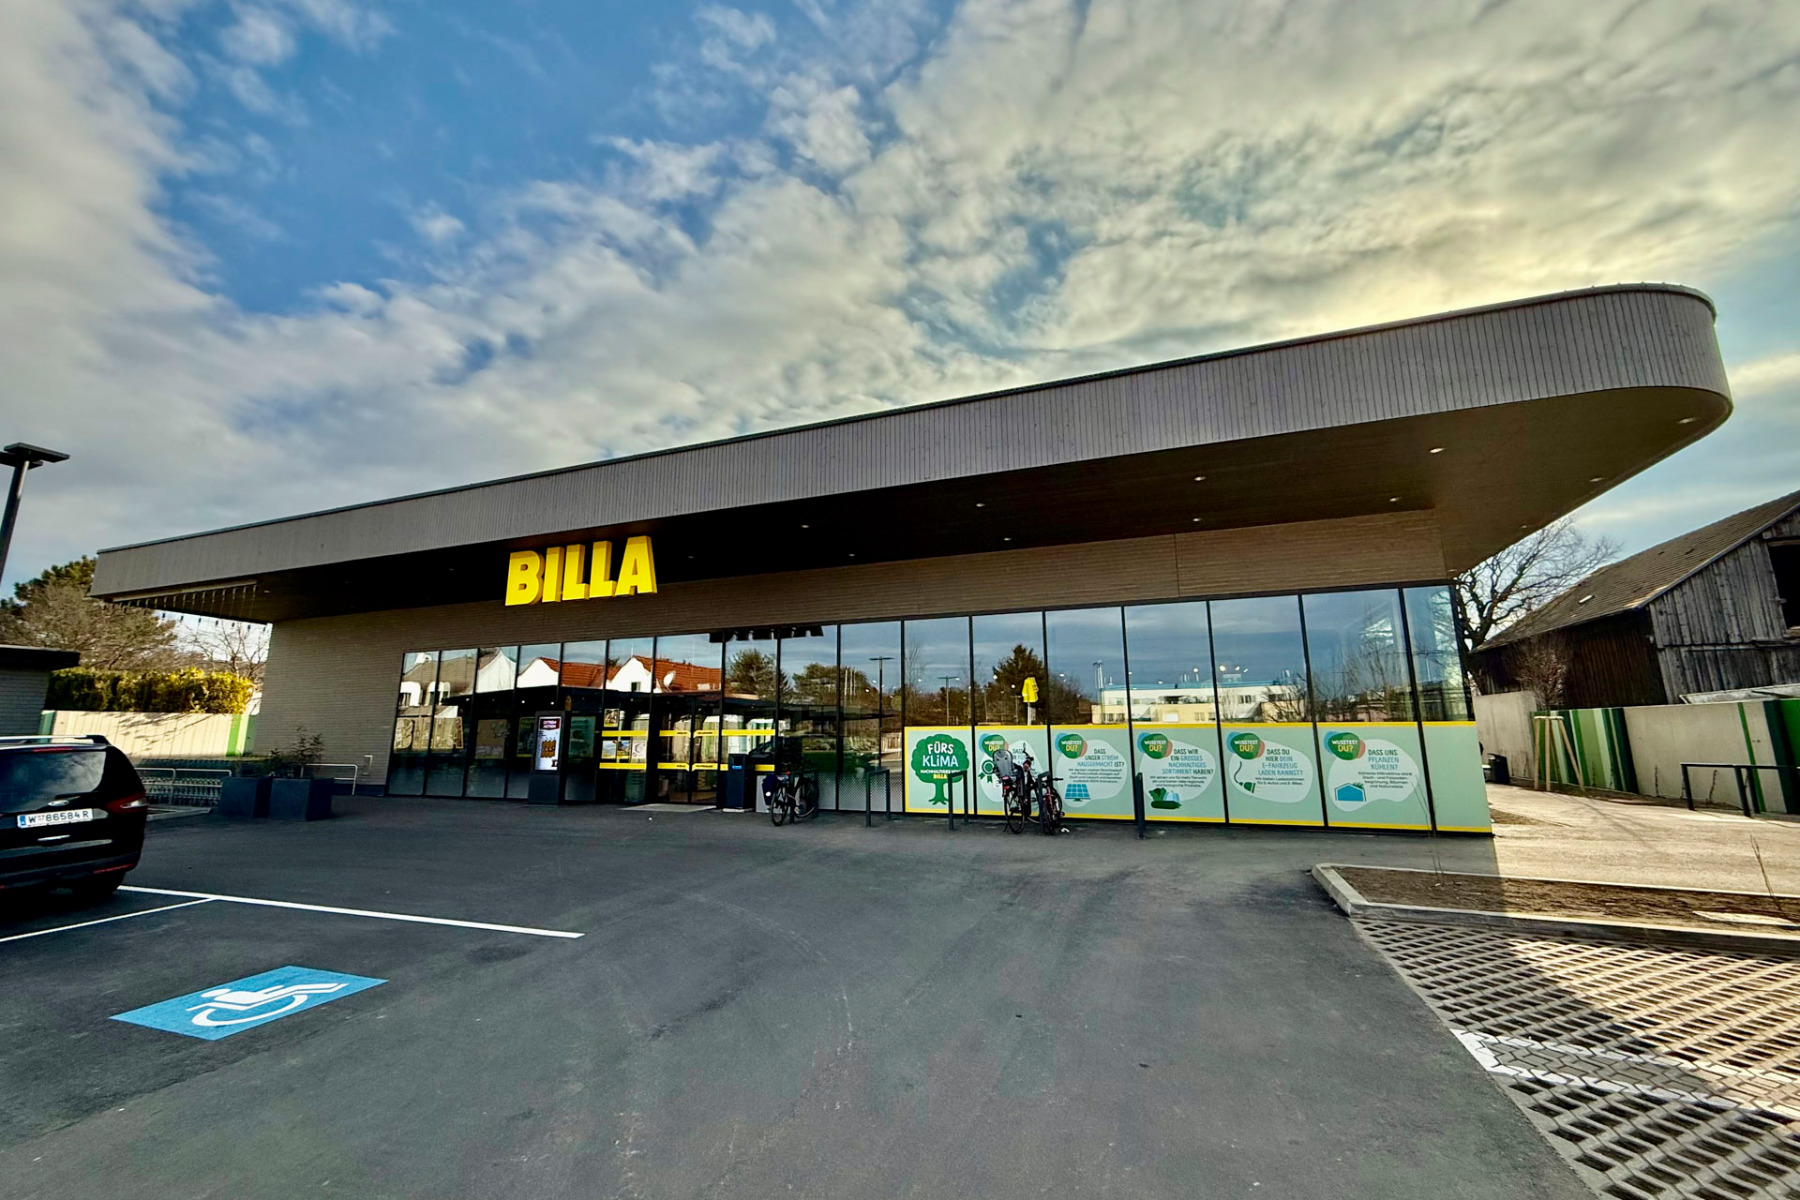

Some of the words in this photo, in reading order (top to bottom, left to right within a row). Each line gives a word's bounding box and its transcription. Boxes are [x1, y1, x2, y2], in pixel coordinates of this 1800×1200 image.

[505, 535, 658, 606] BILLA
[928, 741, 954, 754] FÜRS
[46, 812, 80, 822] 86584
